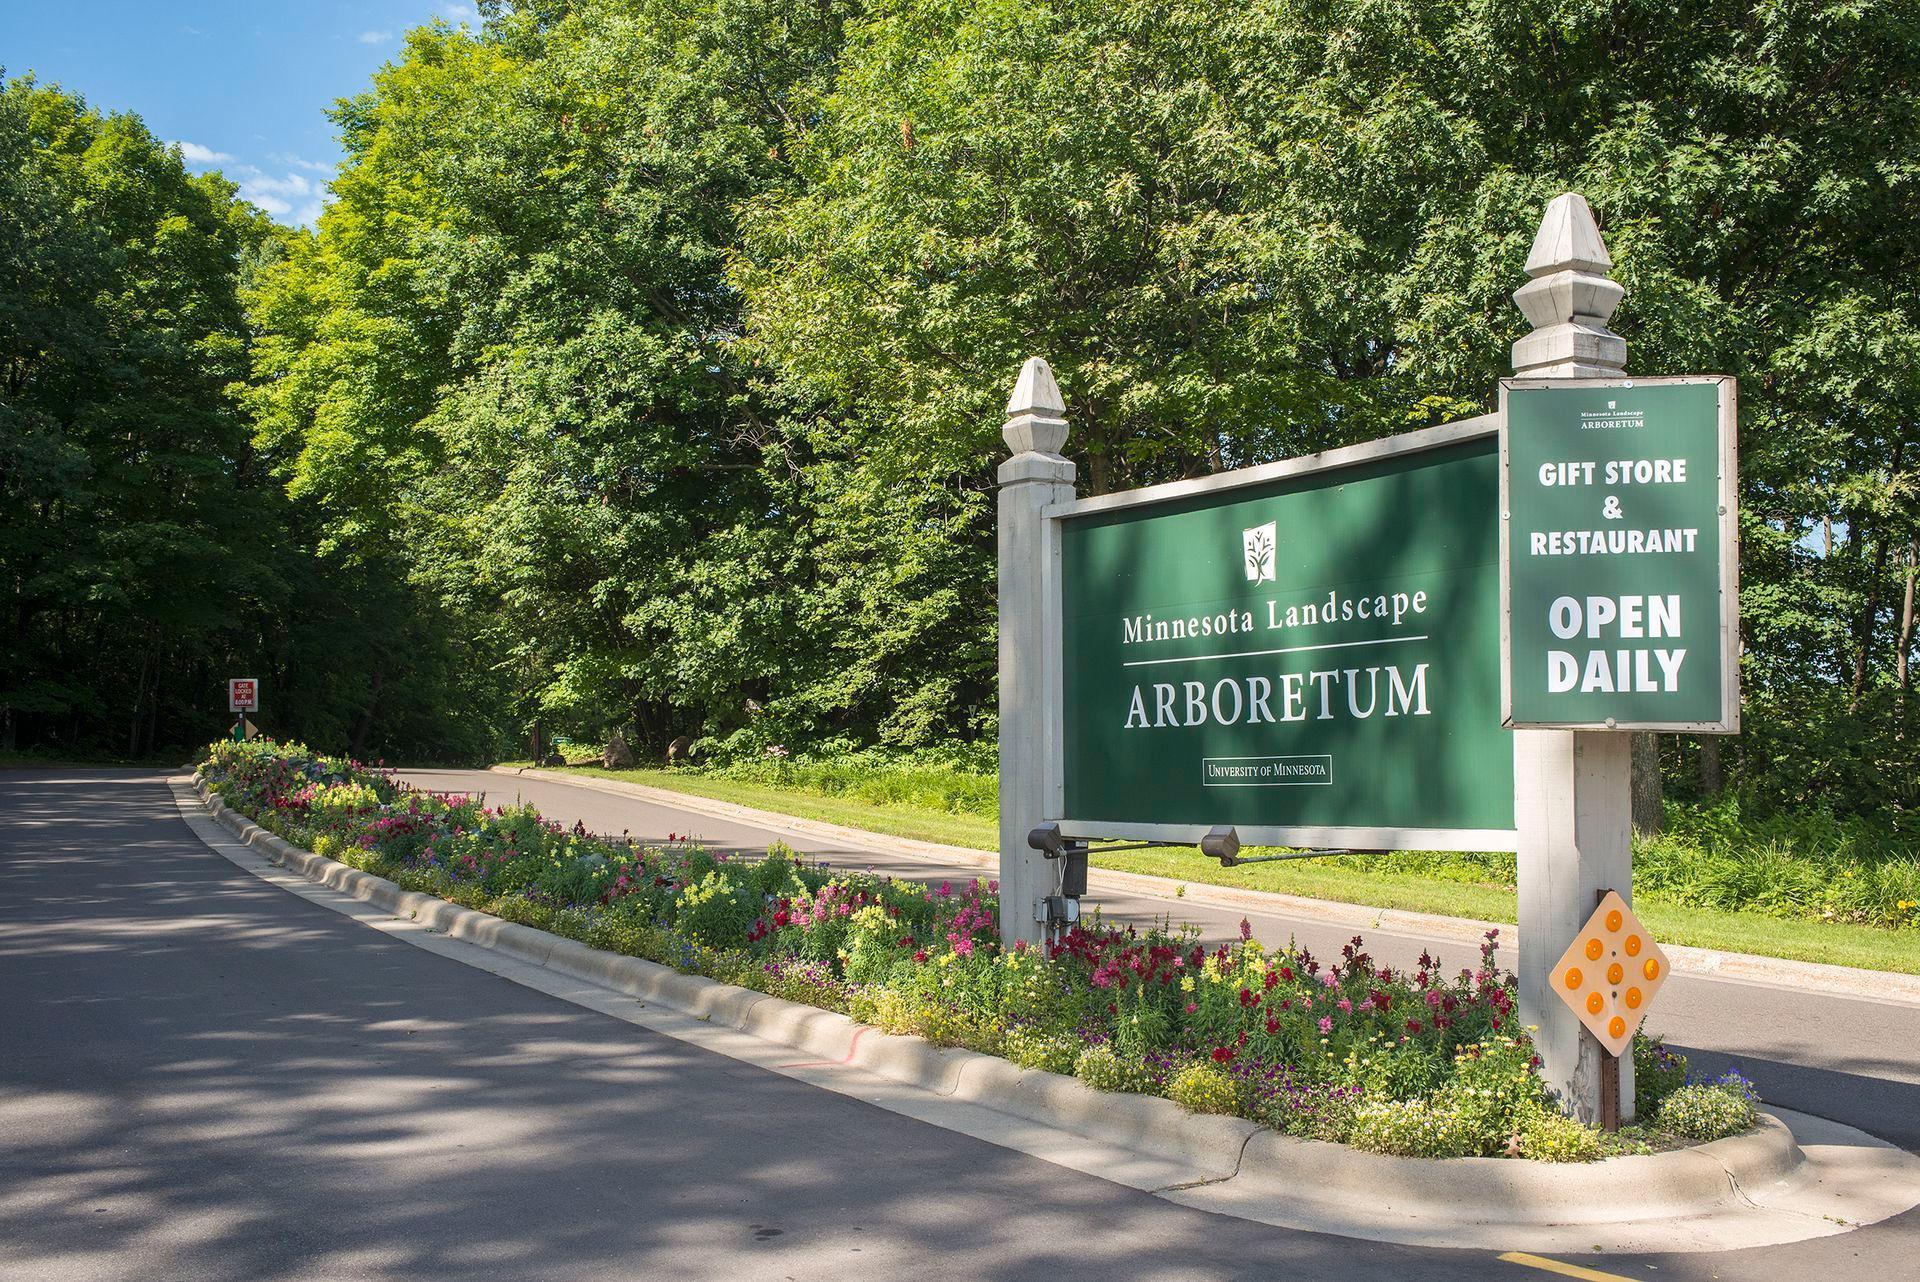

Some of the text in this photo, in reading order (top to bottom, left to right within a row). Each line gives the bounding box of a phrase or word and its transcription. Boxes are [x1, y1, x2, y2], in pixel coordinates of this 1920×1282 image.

[1581, 420, 1644, 429] ARBORETUM
[1538, 459, 1687, 487] GIFT STORE
[1602, 495, 1624, 520] &
[1530, 528, 1699, 556] RESTAURANT
[1122, 590, 1428, 644] Minnesota Landscape
[1548, 594, 1681, 640] OPEN
[1547, 649, 1687, 693] DAILY
[1123, 663, 1432, 729] ARBORETUM
[1208, 763, 1326, 777] UNIVERSITY OF MINNESOTA
